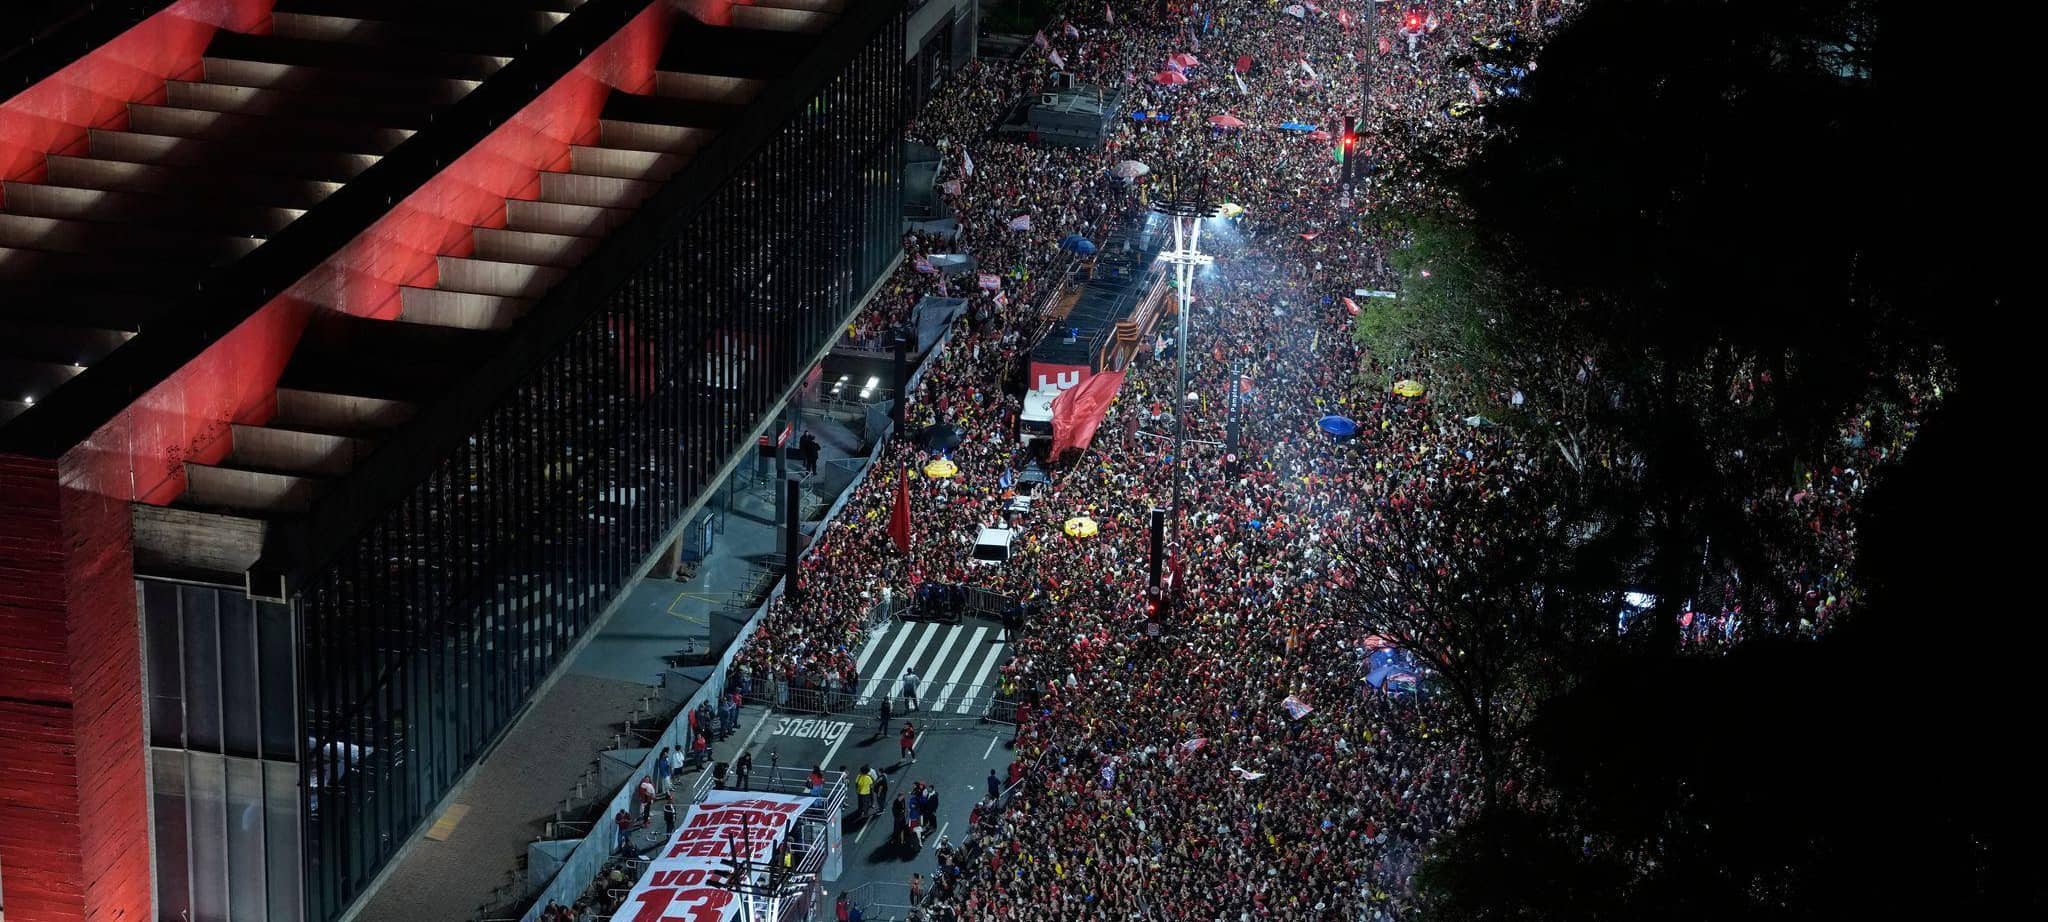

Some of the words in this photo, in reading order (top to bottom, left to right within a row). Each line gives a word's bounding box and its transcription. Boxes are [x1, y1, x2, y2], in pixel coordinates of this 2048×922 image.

[772, 717, 846, 746] ÔNIBUS
[688, 810, 788, 828] MEDO
[677, 826, 718, 842] DE
[719, 826, 777, 842] SER
[666, 840, 769, 859] FELIZ
[631, 888, 735, 922] 13
